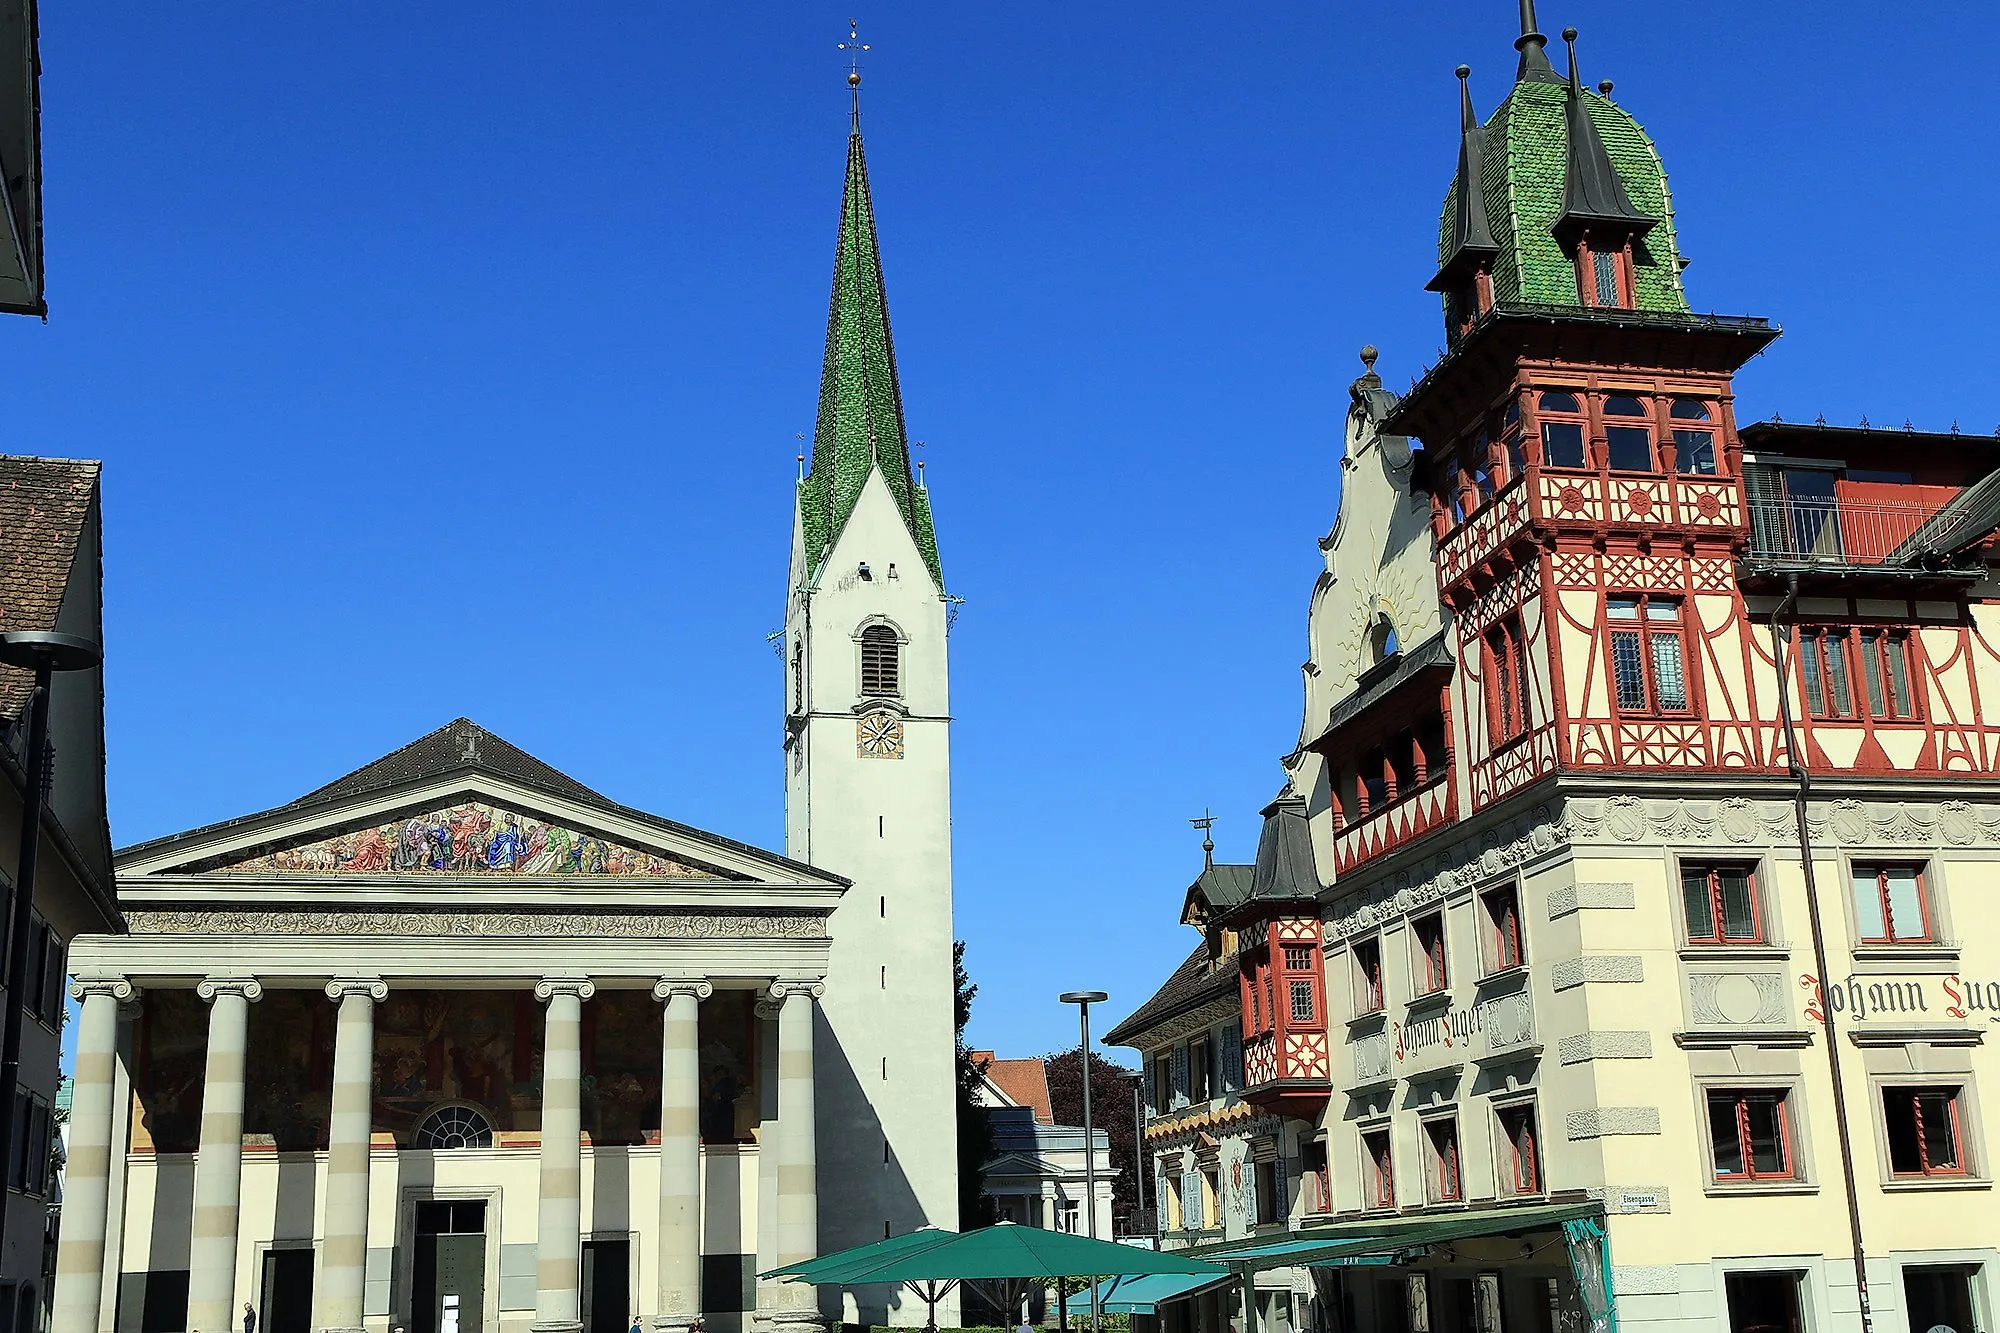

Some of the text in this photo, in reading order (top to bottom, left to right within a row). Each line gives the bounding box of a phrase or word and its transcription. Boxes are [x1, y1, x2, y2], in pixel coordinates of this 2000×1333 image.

[1393, 1004, 1484, 1064] Johann Luger
[1623, 1194, 1656, 1205] Eisengasse
